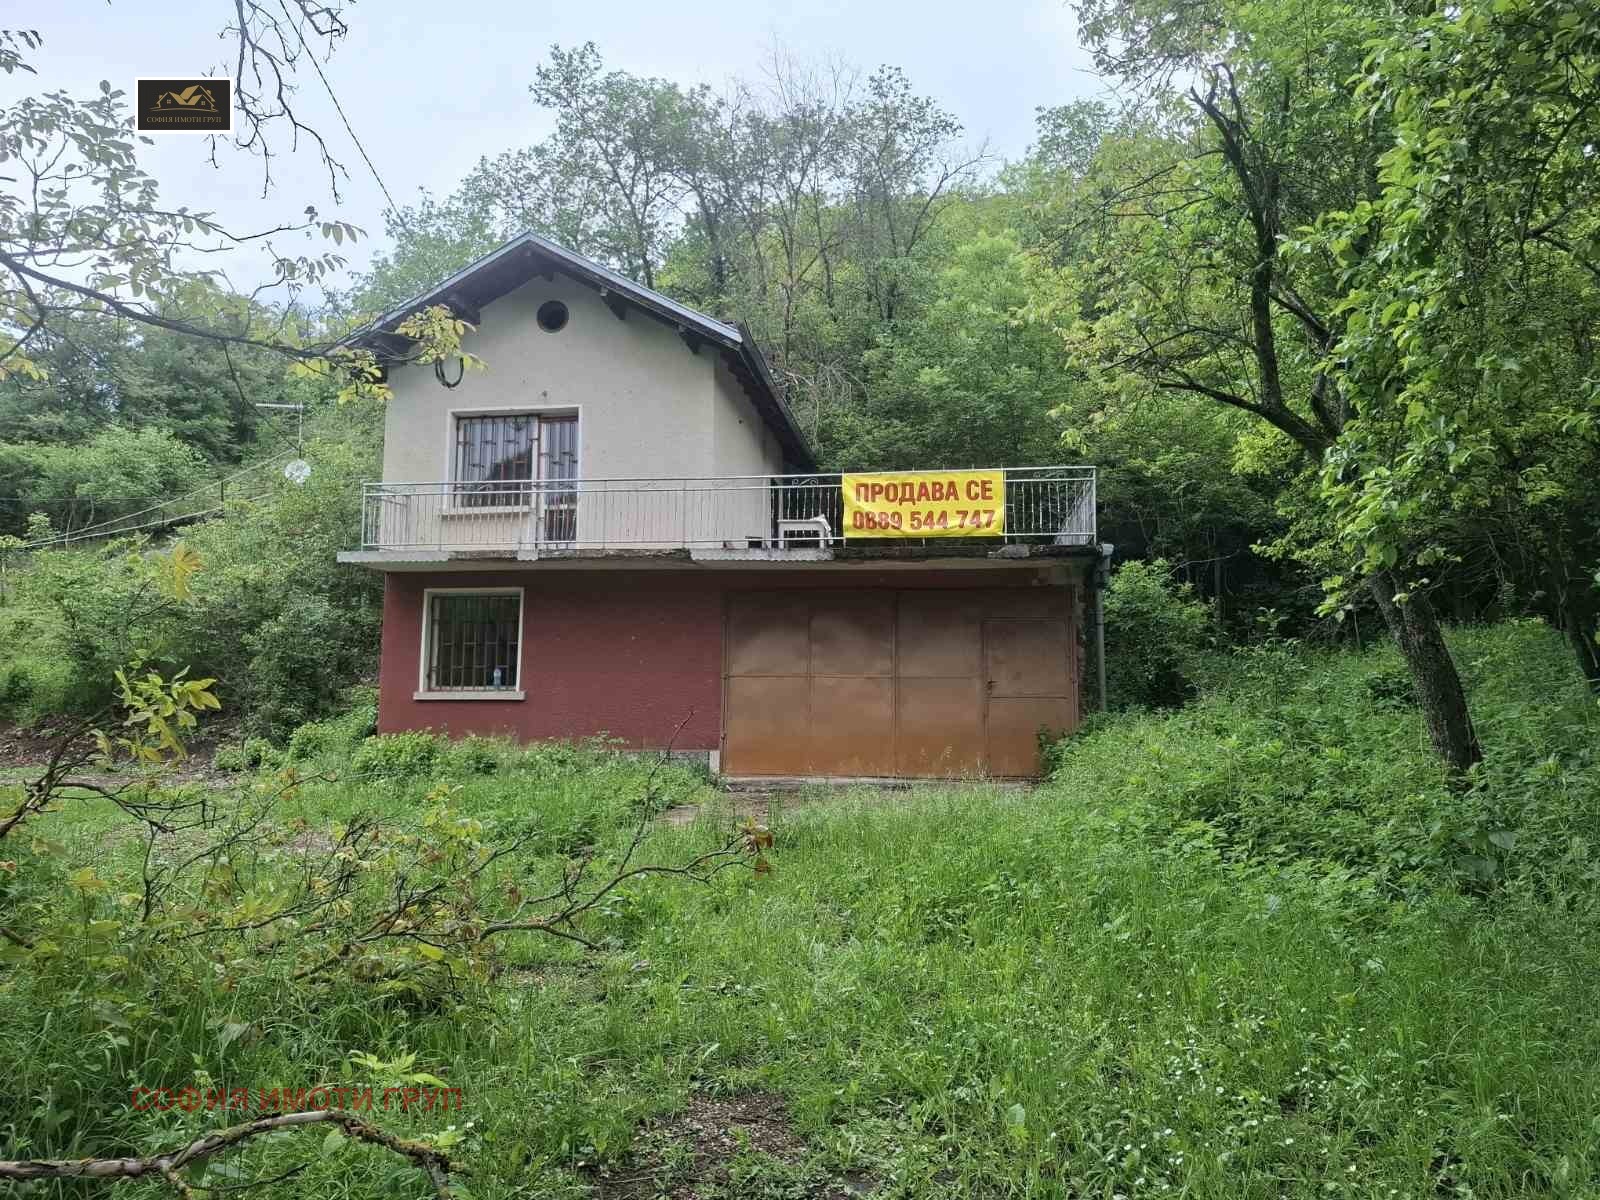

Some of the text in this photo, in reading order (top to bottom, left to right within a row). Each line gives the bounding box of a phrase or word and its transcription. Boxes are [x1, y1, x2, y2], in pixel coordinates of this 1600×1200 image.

[856, 479, 994, 506] ПРОДАВА СЕ
[853, 509, 996, 530] 0889 544 747
